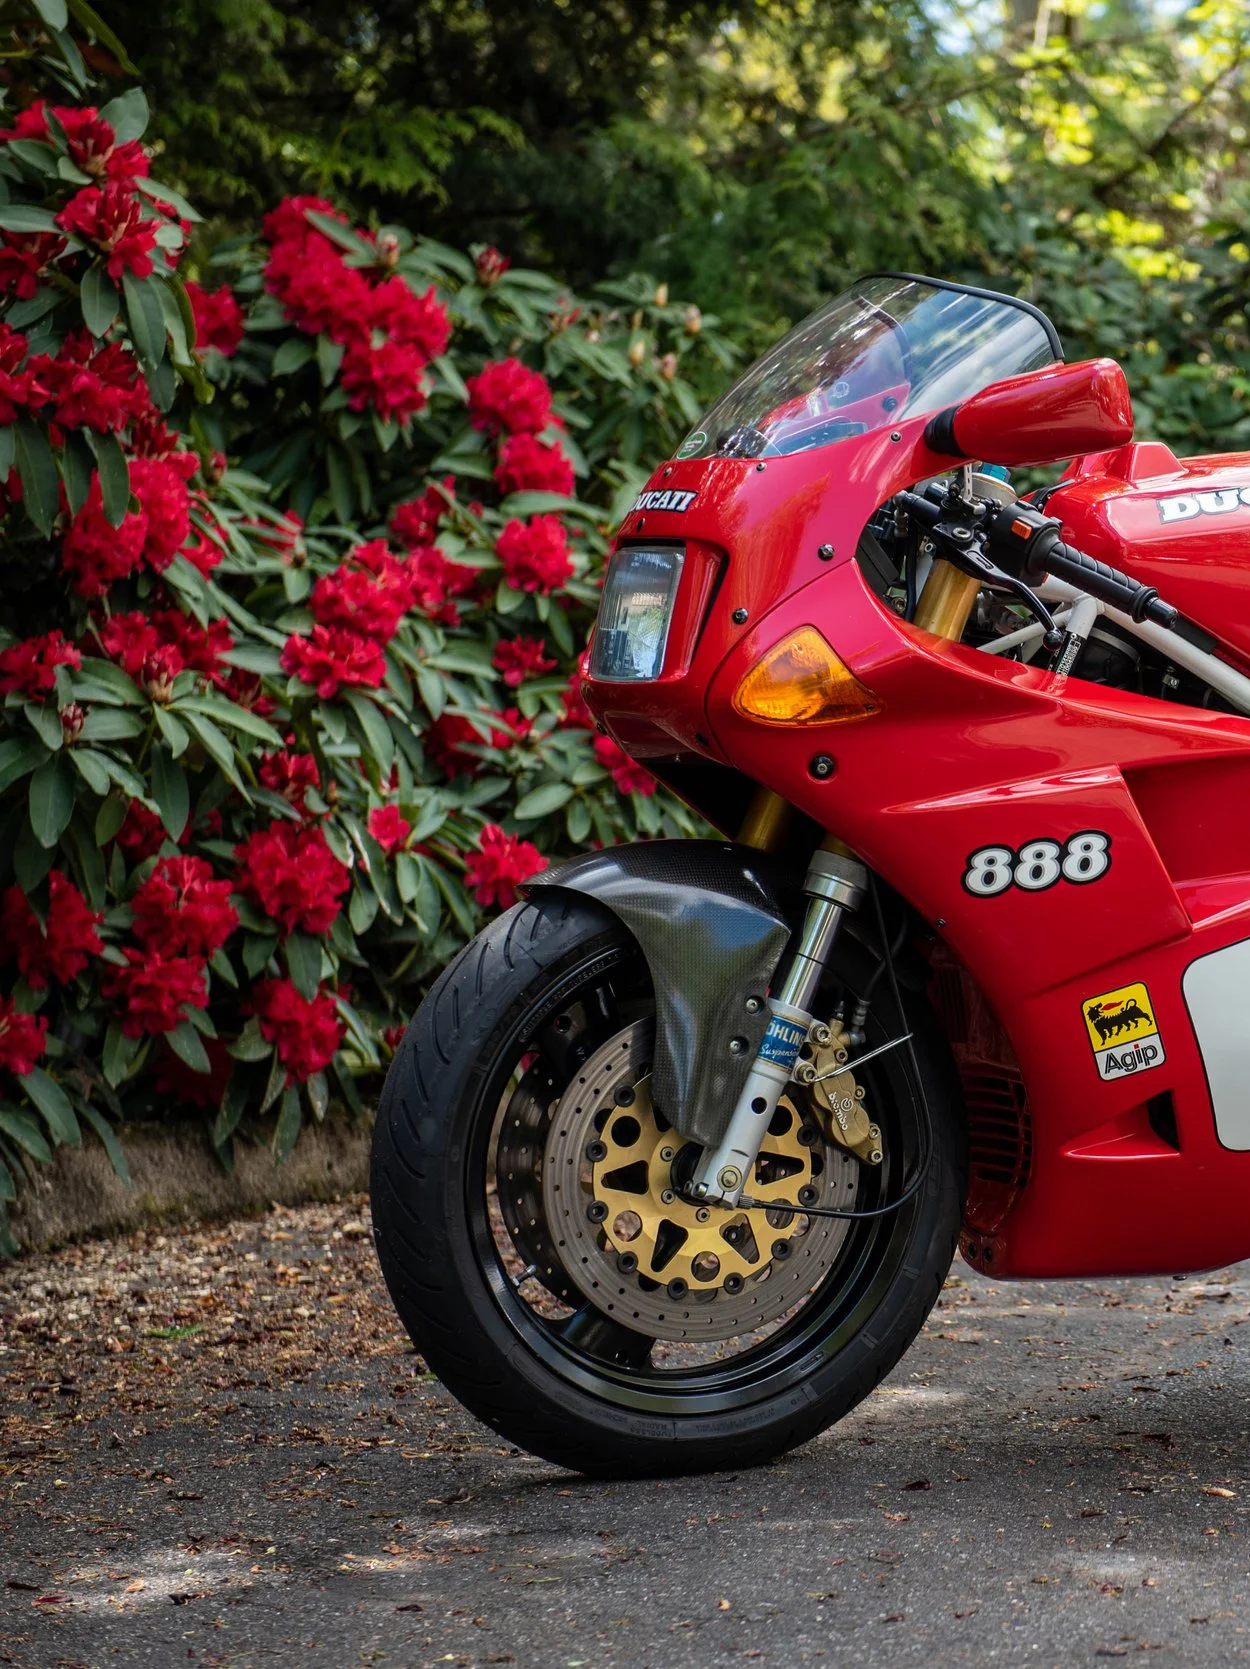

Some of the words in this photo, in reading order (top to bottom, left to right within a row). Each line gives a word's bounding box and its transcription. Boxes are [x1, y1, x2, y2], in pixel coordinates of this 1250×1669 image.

[962, 831, 1111, 897] 888
[1104, 1043, 1158, 1074] Agip
[828, 1091, 848, 1130] brembo
